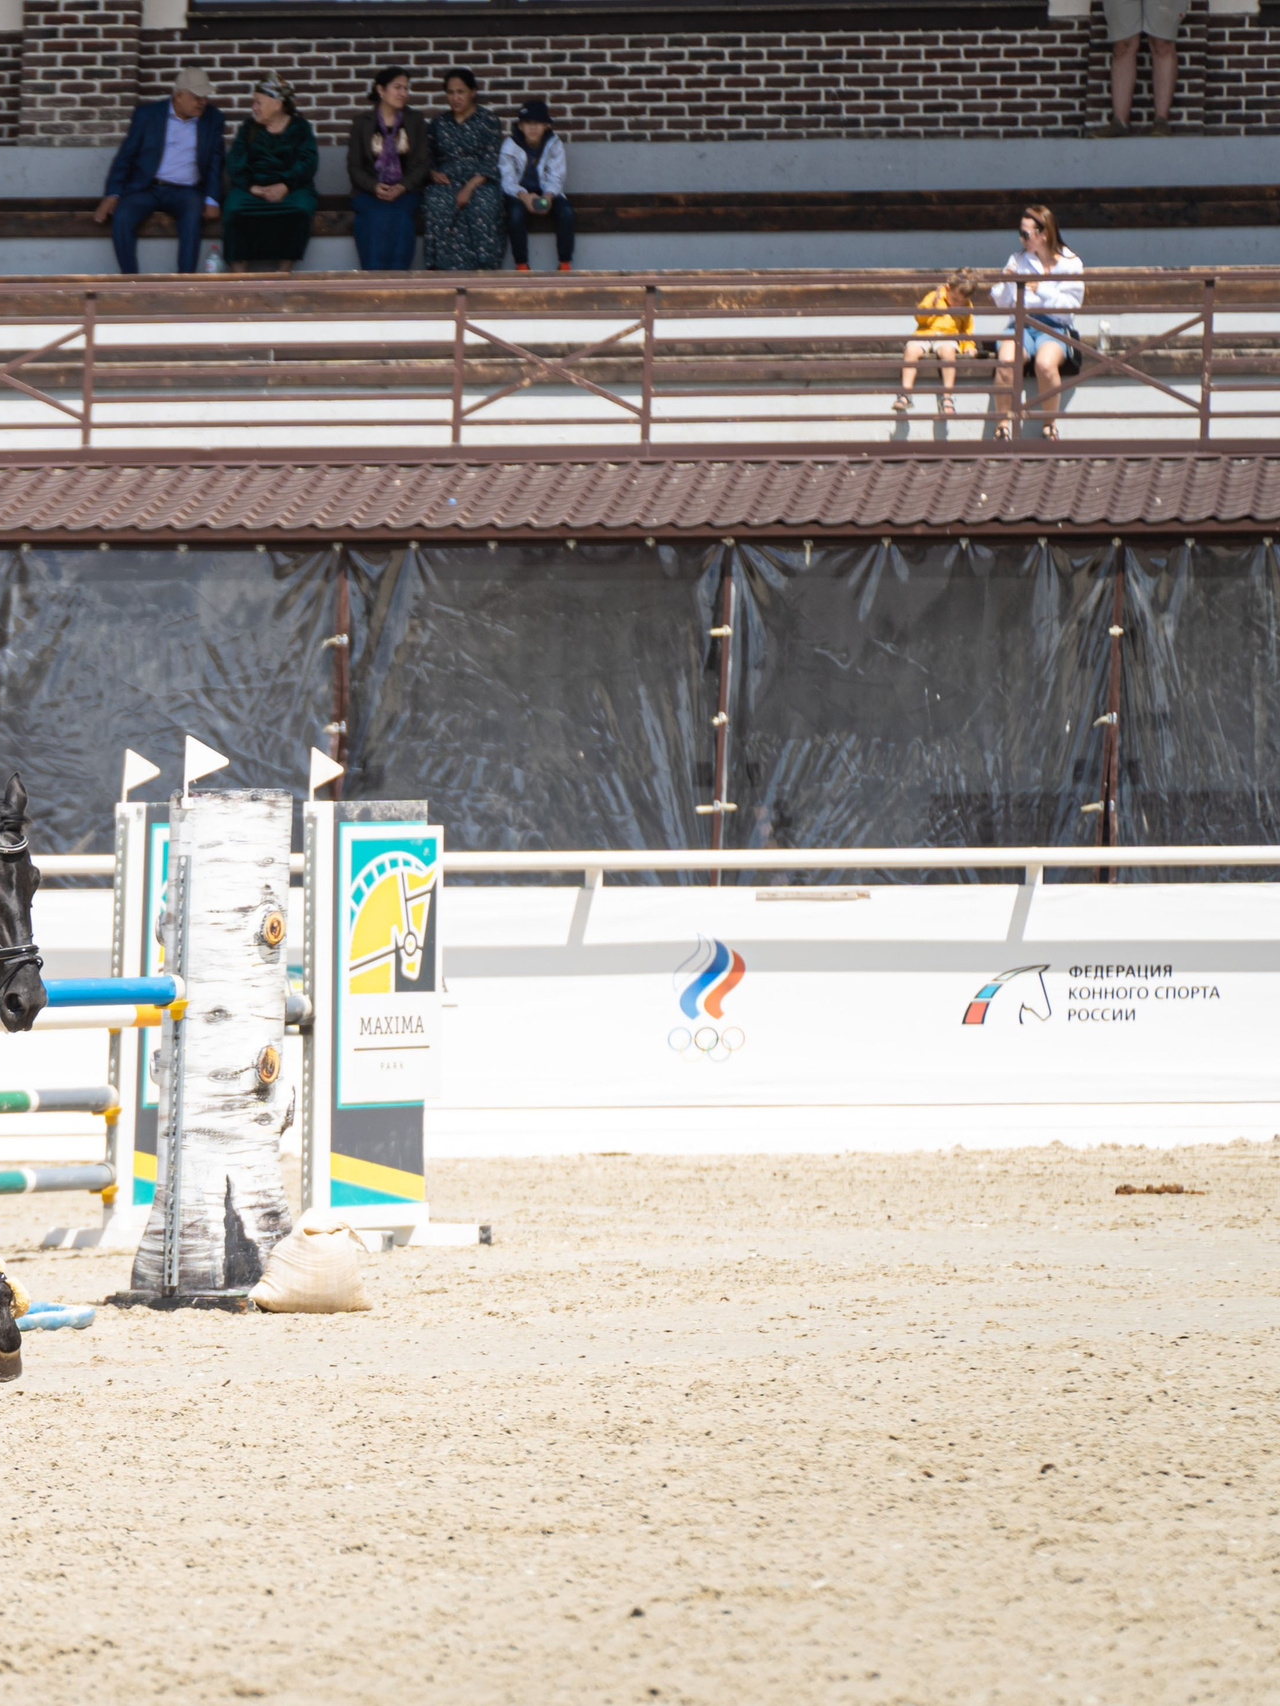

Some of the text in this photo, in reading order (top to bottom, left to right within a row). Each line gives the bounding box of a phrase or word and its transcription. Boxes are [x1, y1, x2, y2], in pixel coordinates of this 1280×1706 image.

[1069, 964, 1173, 980] ФЕДЕРАЦИЯ
[1069, 986, 1221, 1000] КОННОГО СПОРТА
[1067, 1008, 1137, 1022] РОССИИ
[359, 1015, 425, 1035] MAXIMA
